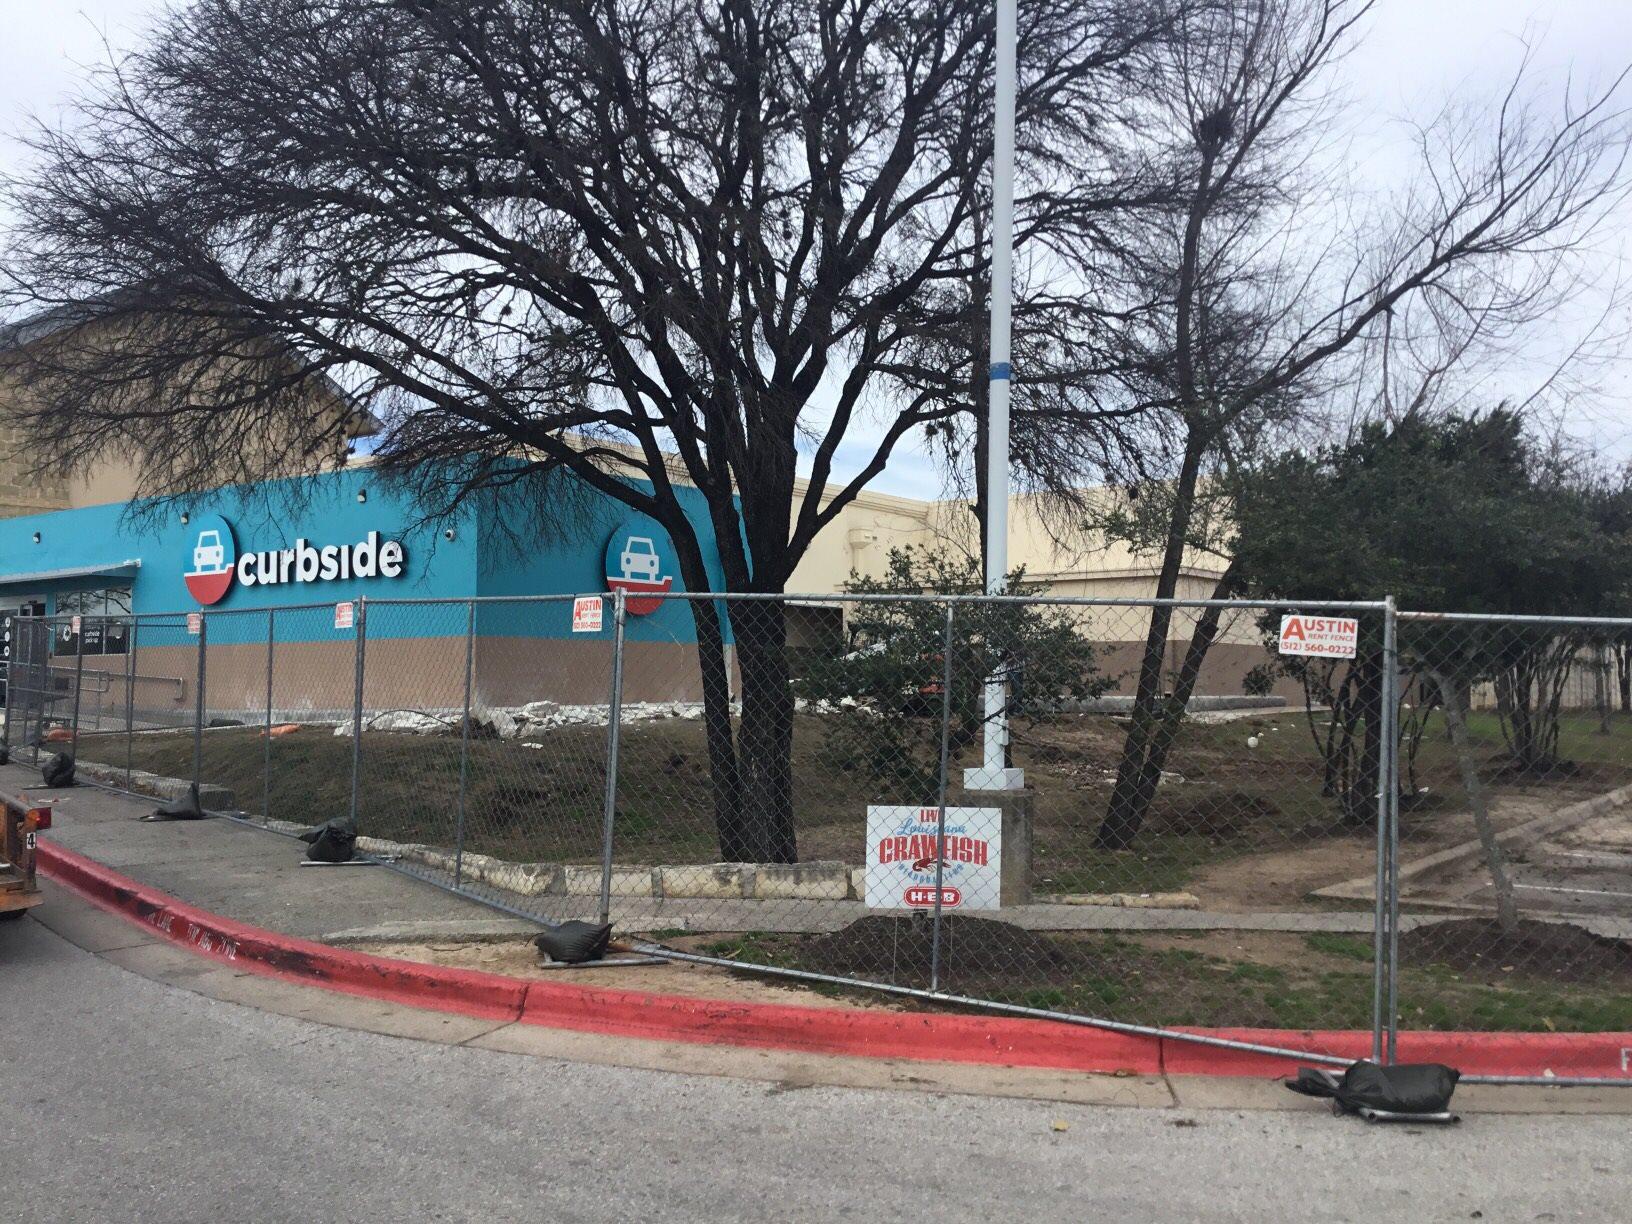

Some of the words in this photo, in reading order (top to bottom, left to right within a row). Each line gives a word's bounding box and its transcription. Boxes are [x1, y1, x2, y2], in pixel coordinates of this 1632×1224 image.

[237, 531, 403, 587] curbside
[574, 600, 602, 620] AUSTIN
[1282, 618, 1356, 641] AUSTIN
[1331, 633, 1354, 642] FENCE
[1280, 641, 1302, 651] (512)
[1304, 643, 1355, 655] 560-0222
[920, 809, 942, 822] LIV
[27, 833, 35, 848] 4
